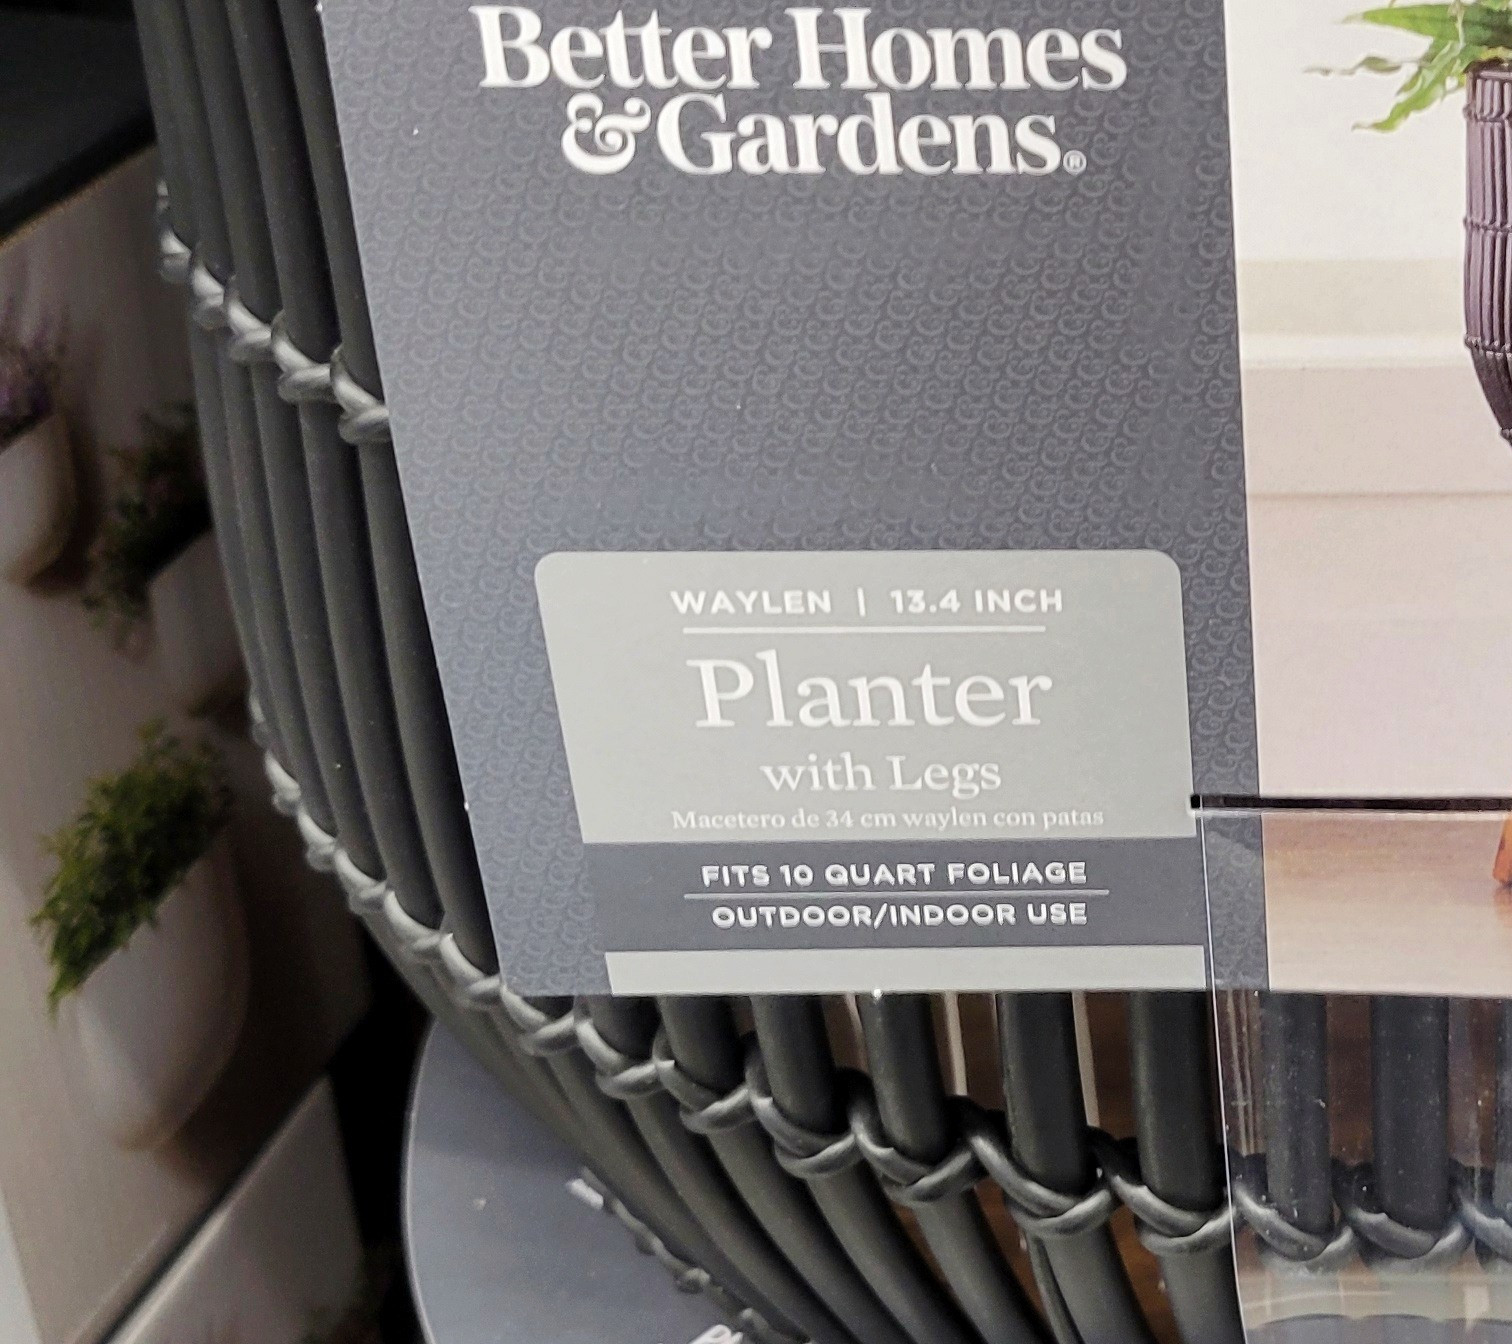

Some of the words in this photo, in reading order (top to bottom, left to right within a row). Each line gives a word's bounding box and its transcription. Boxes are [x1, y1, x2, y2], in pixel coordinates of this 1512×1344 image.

[469, 5, 772, 88] Better
[785, 6, 1128, 91] Homes
[670, 589, 832, 616] WAYLEN
[890, 589, 961, 613] 13.4
[974, 588, 1063, 613] INCH
[686, 649, 1053, 729] Planter
[759, 753, 873, 792] with
[890, 754, 1002, 799] Legs
[671, 810, 787, 831] Macetero
[790, 809, 821, 830] de
[825, 810, 855, 829] 34
[859, 812, 897, 829] cm
[901, 808, 988, 833] waylen
[992, 811, 1036, 828] con
[1042, 808, 1105, 832] patas
[701, 864, 770, 888] FITS
[779, 863, 814, 887] 10
[825, 862, 935, 887] QUART
[946, 861, 1087, 886] FOLIAGE
[711, 903, 1016, 930] OUTDOOR/INDOOR
[1027, 902, 1088, 926] USE
